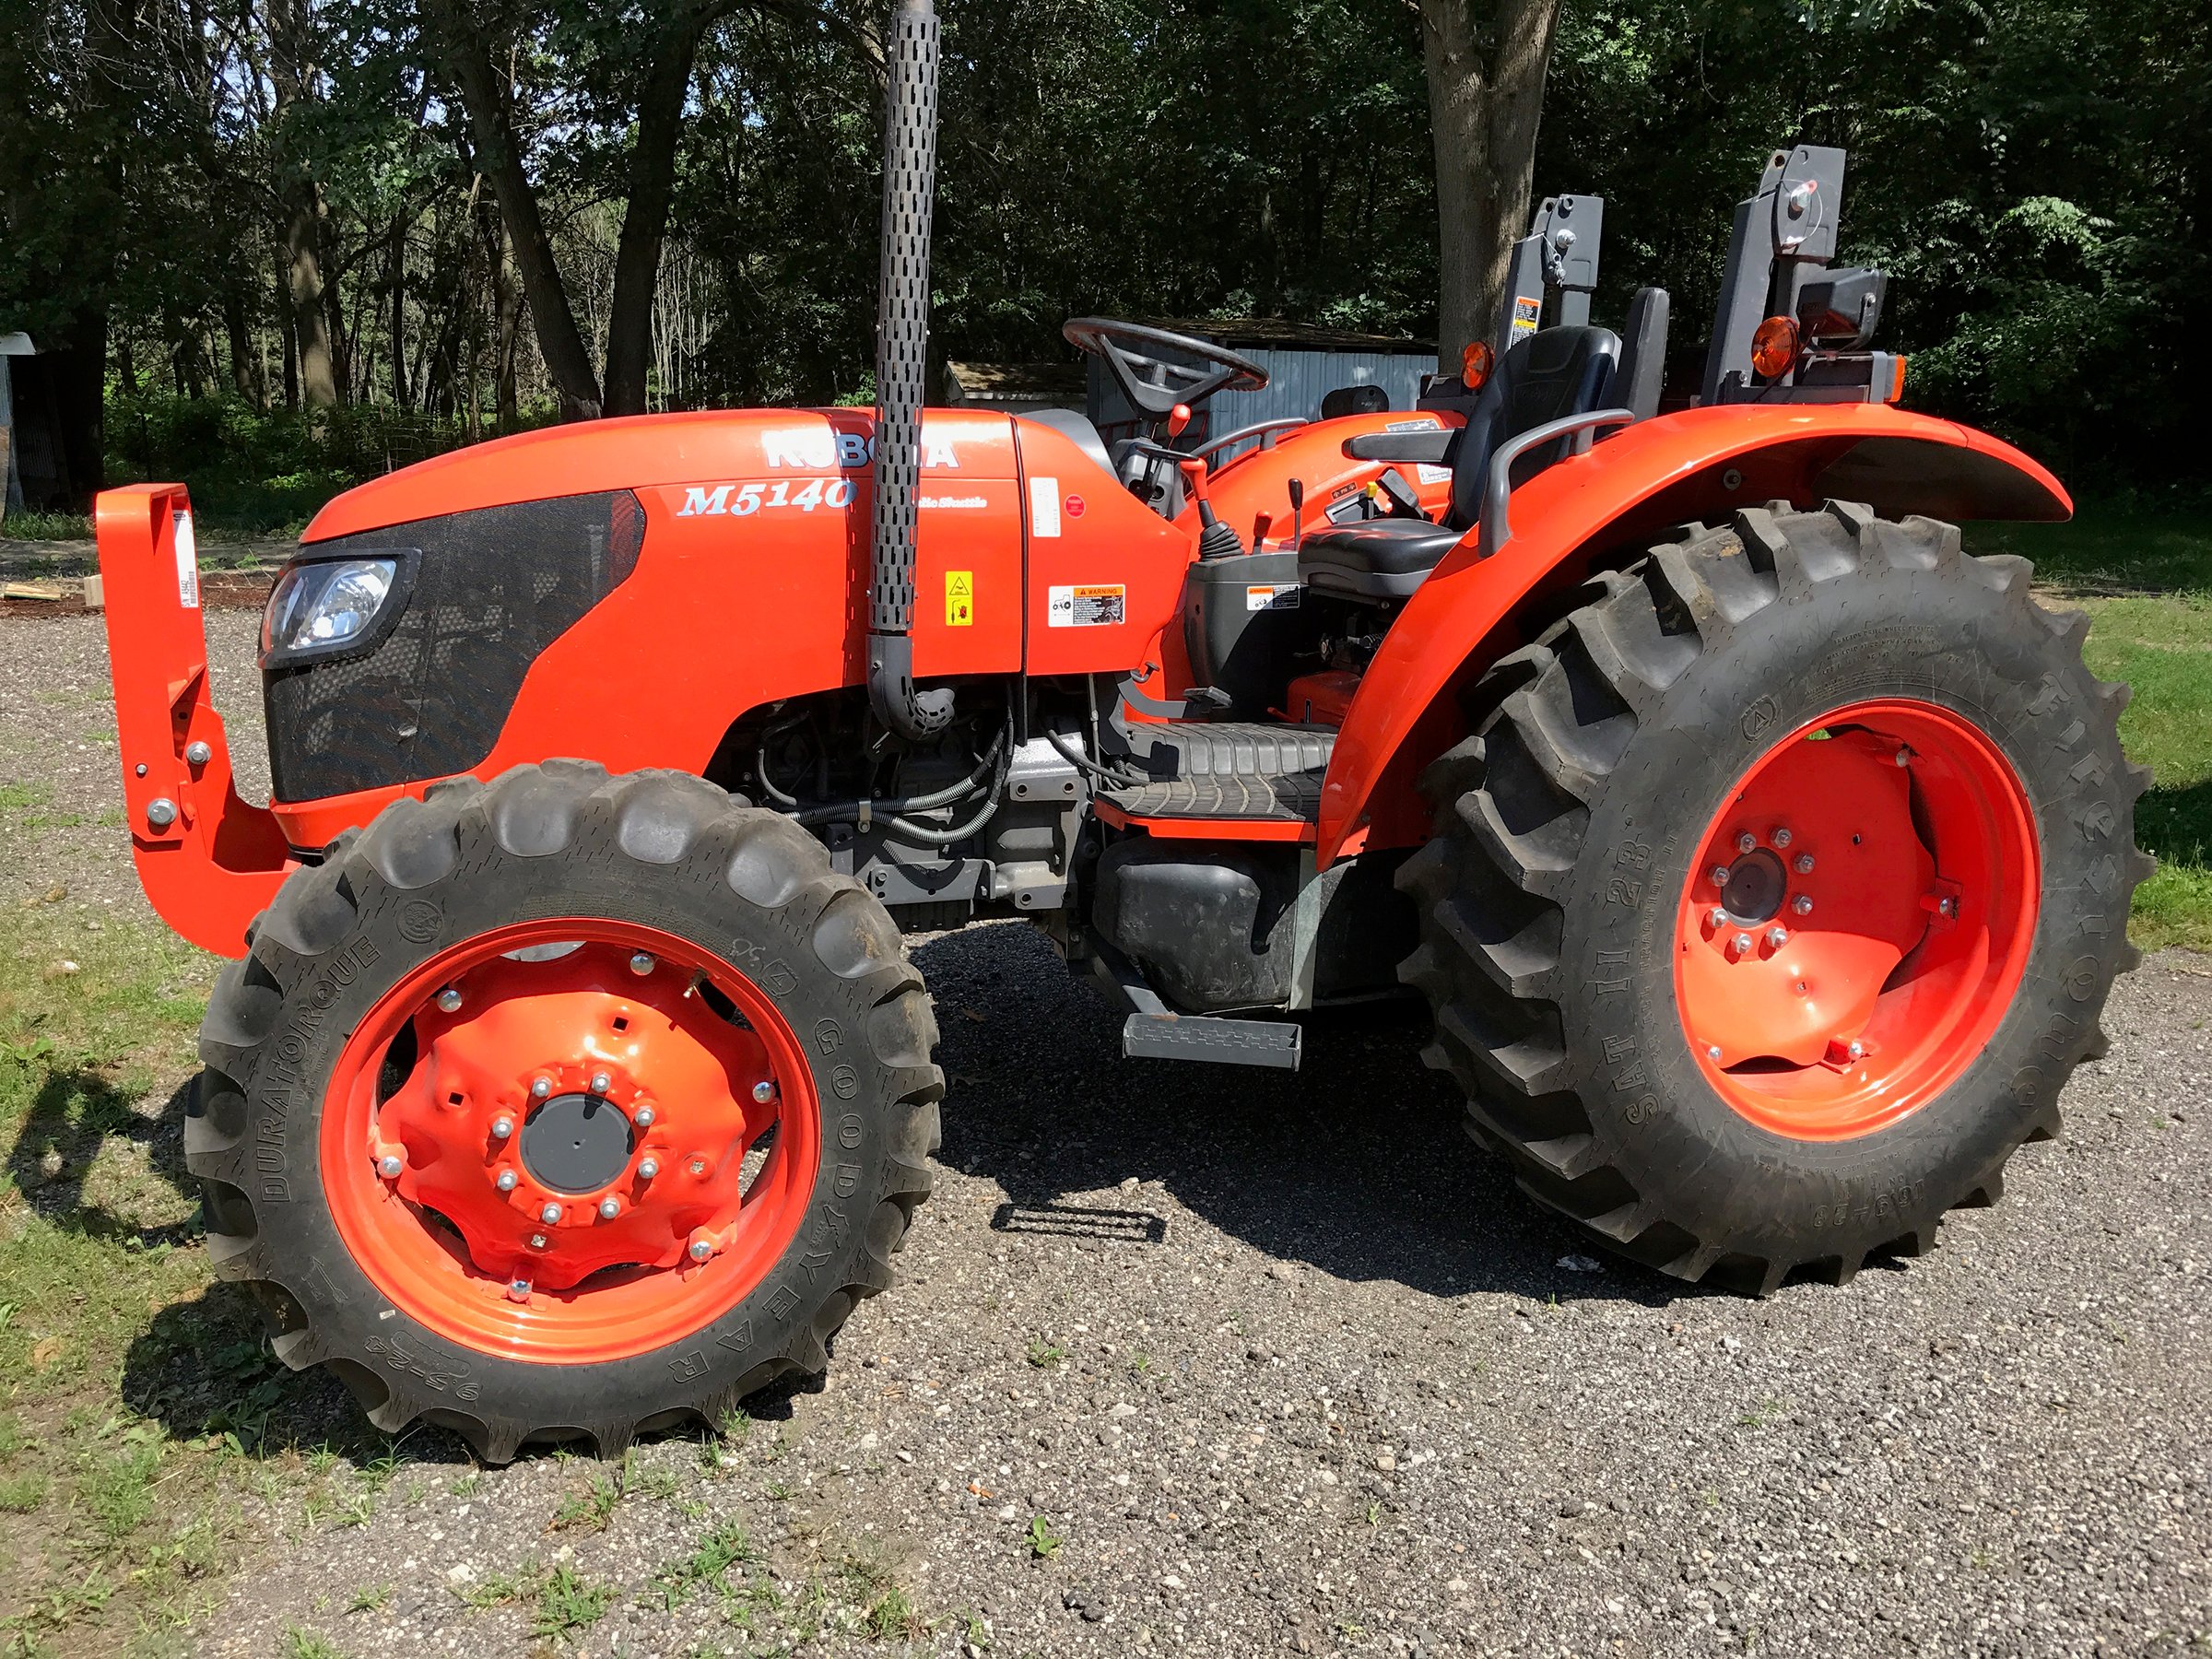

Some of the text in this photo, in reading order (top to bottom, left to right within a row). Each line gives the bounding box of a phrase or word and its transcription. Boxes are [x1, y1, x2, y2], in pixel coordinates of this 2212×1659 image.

[761, 429, 959, 468] KUBA
[677, 478, 860, 516] M5140
[1639, 868, 1665, 975] TRACTION
[1641, 984, 1655, 1025] ALL
[256, 935, 382, 1203] DURATORQUE
[1601, 1034, 1661, 1124] SAT
[667, 1018, 863, 1384] GOODYEAR
[363, 1335, 479, 1402] 9.5-24
